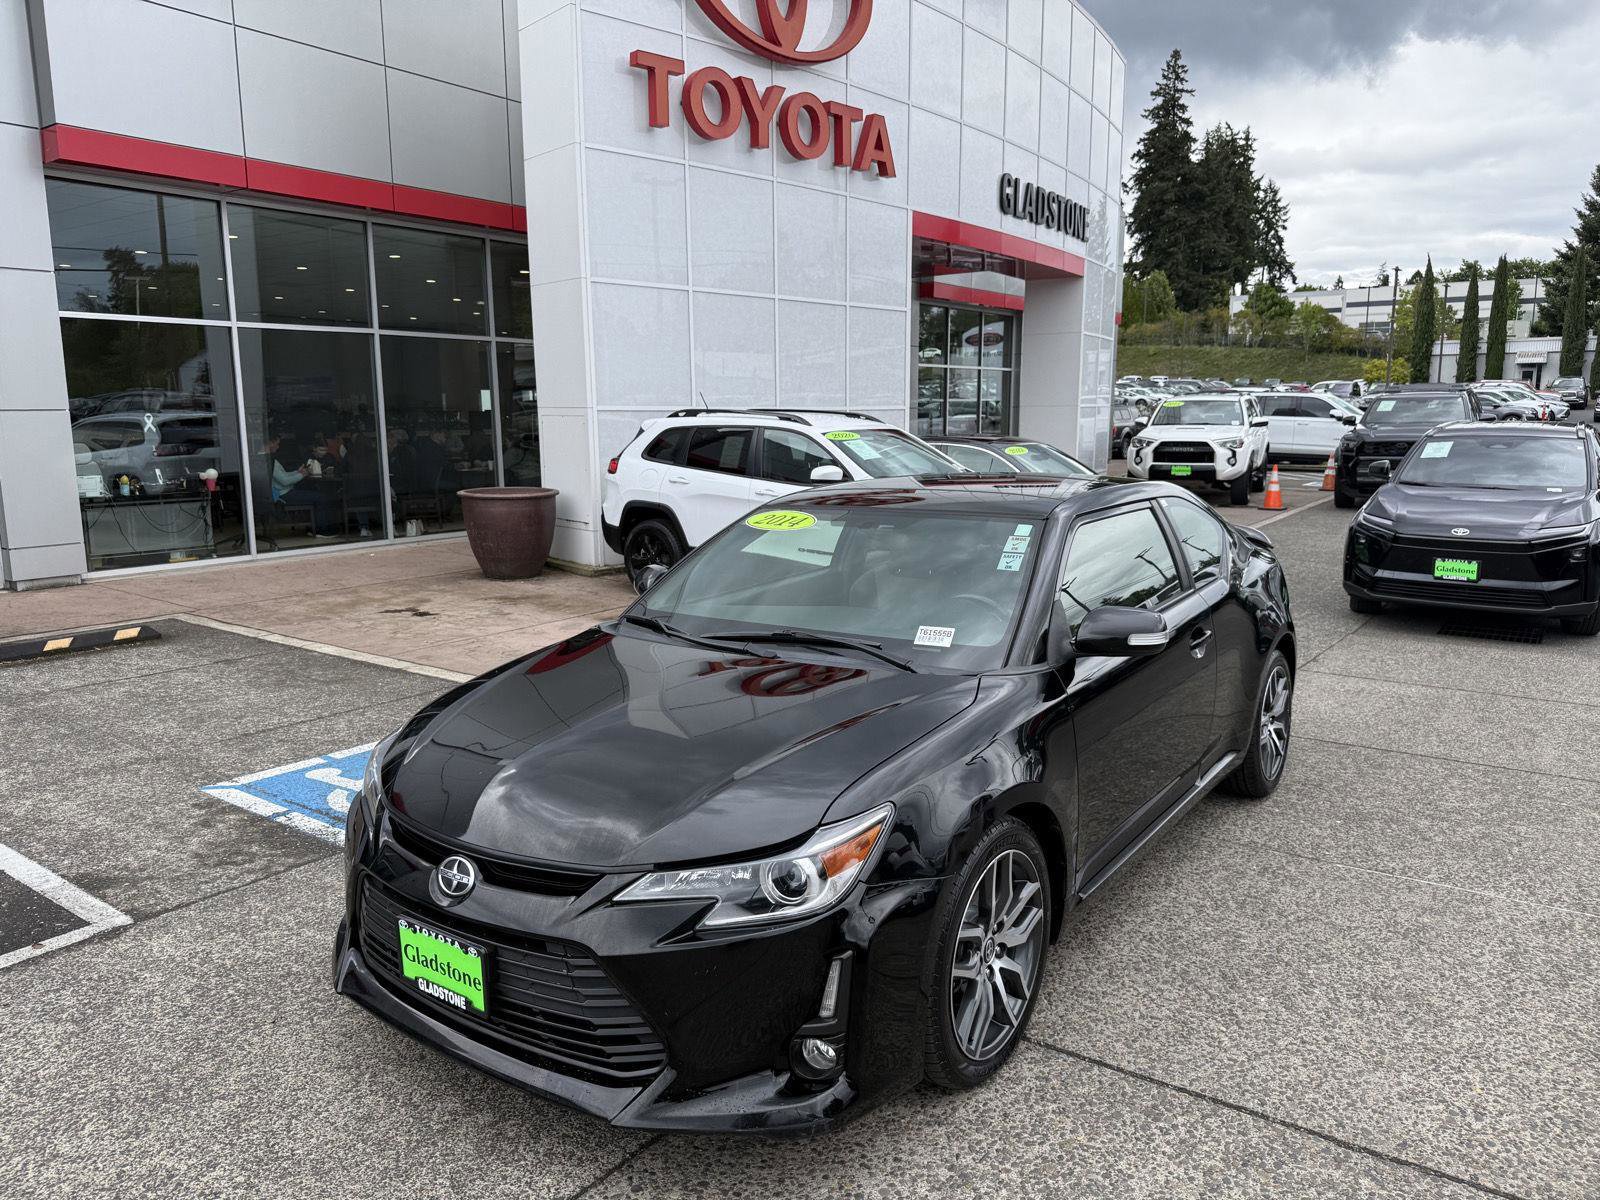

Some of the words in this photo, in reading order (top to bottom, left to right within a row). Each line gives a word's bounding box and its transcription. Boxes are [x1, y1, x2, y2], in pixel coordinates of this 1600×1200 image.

[629, 49, 896, 178] TOYOTA
[999, 172, 1090, 243] GLADSTONE
[753, 515, 808, 527] 2014
[1436, 565, 1476, 575] Gladstone
[414, 924, 460, 949] TOYOTA
[403, 943, 482, 991] Gladstone
[418, 977, 467, 1010] GLADSTONE
